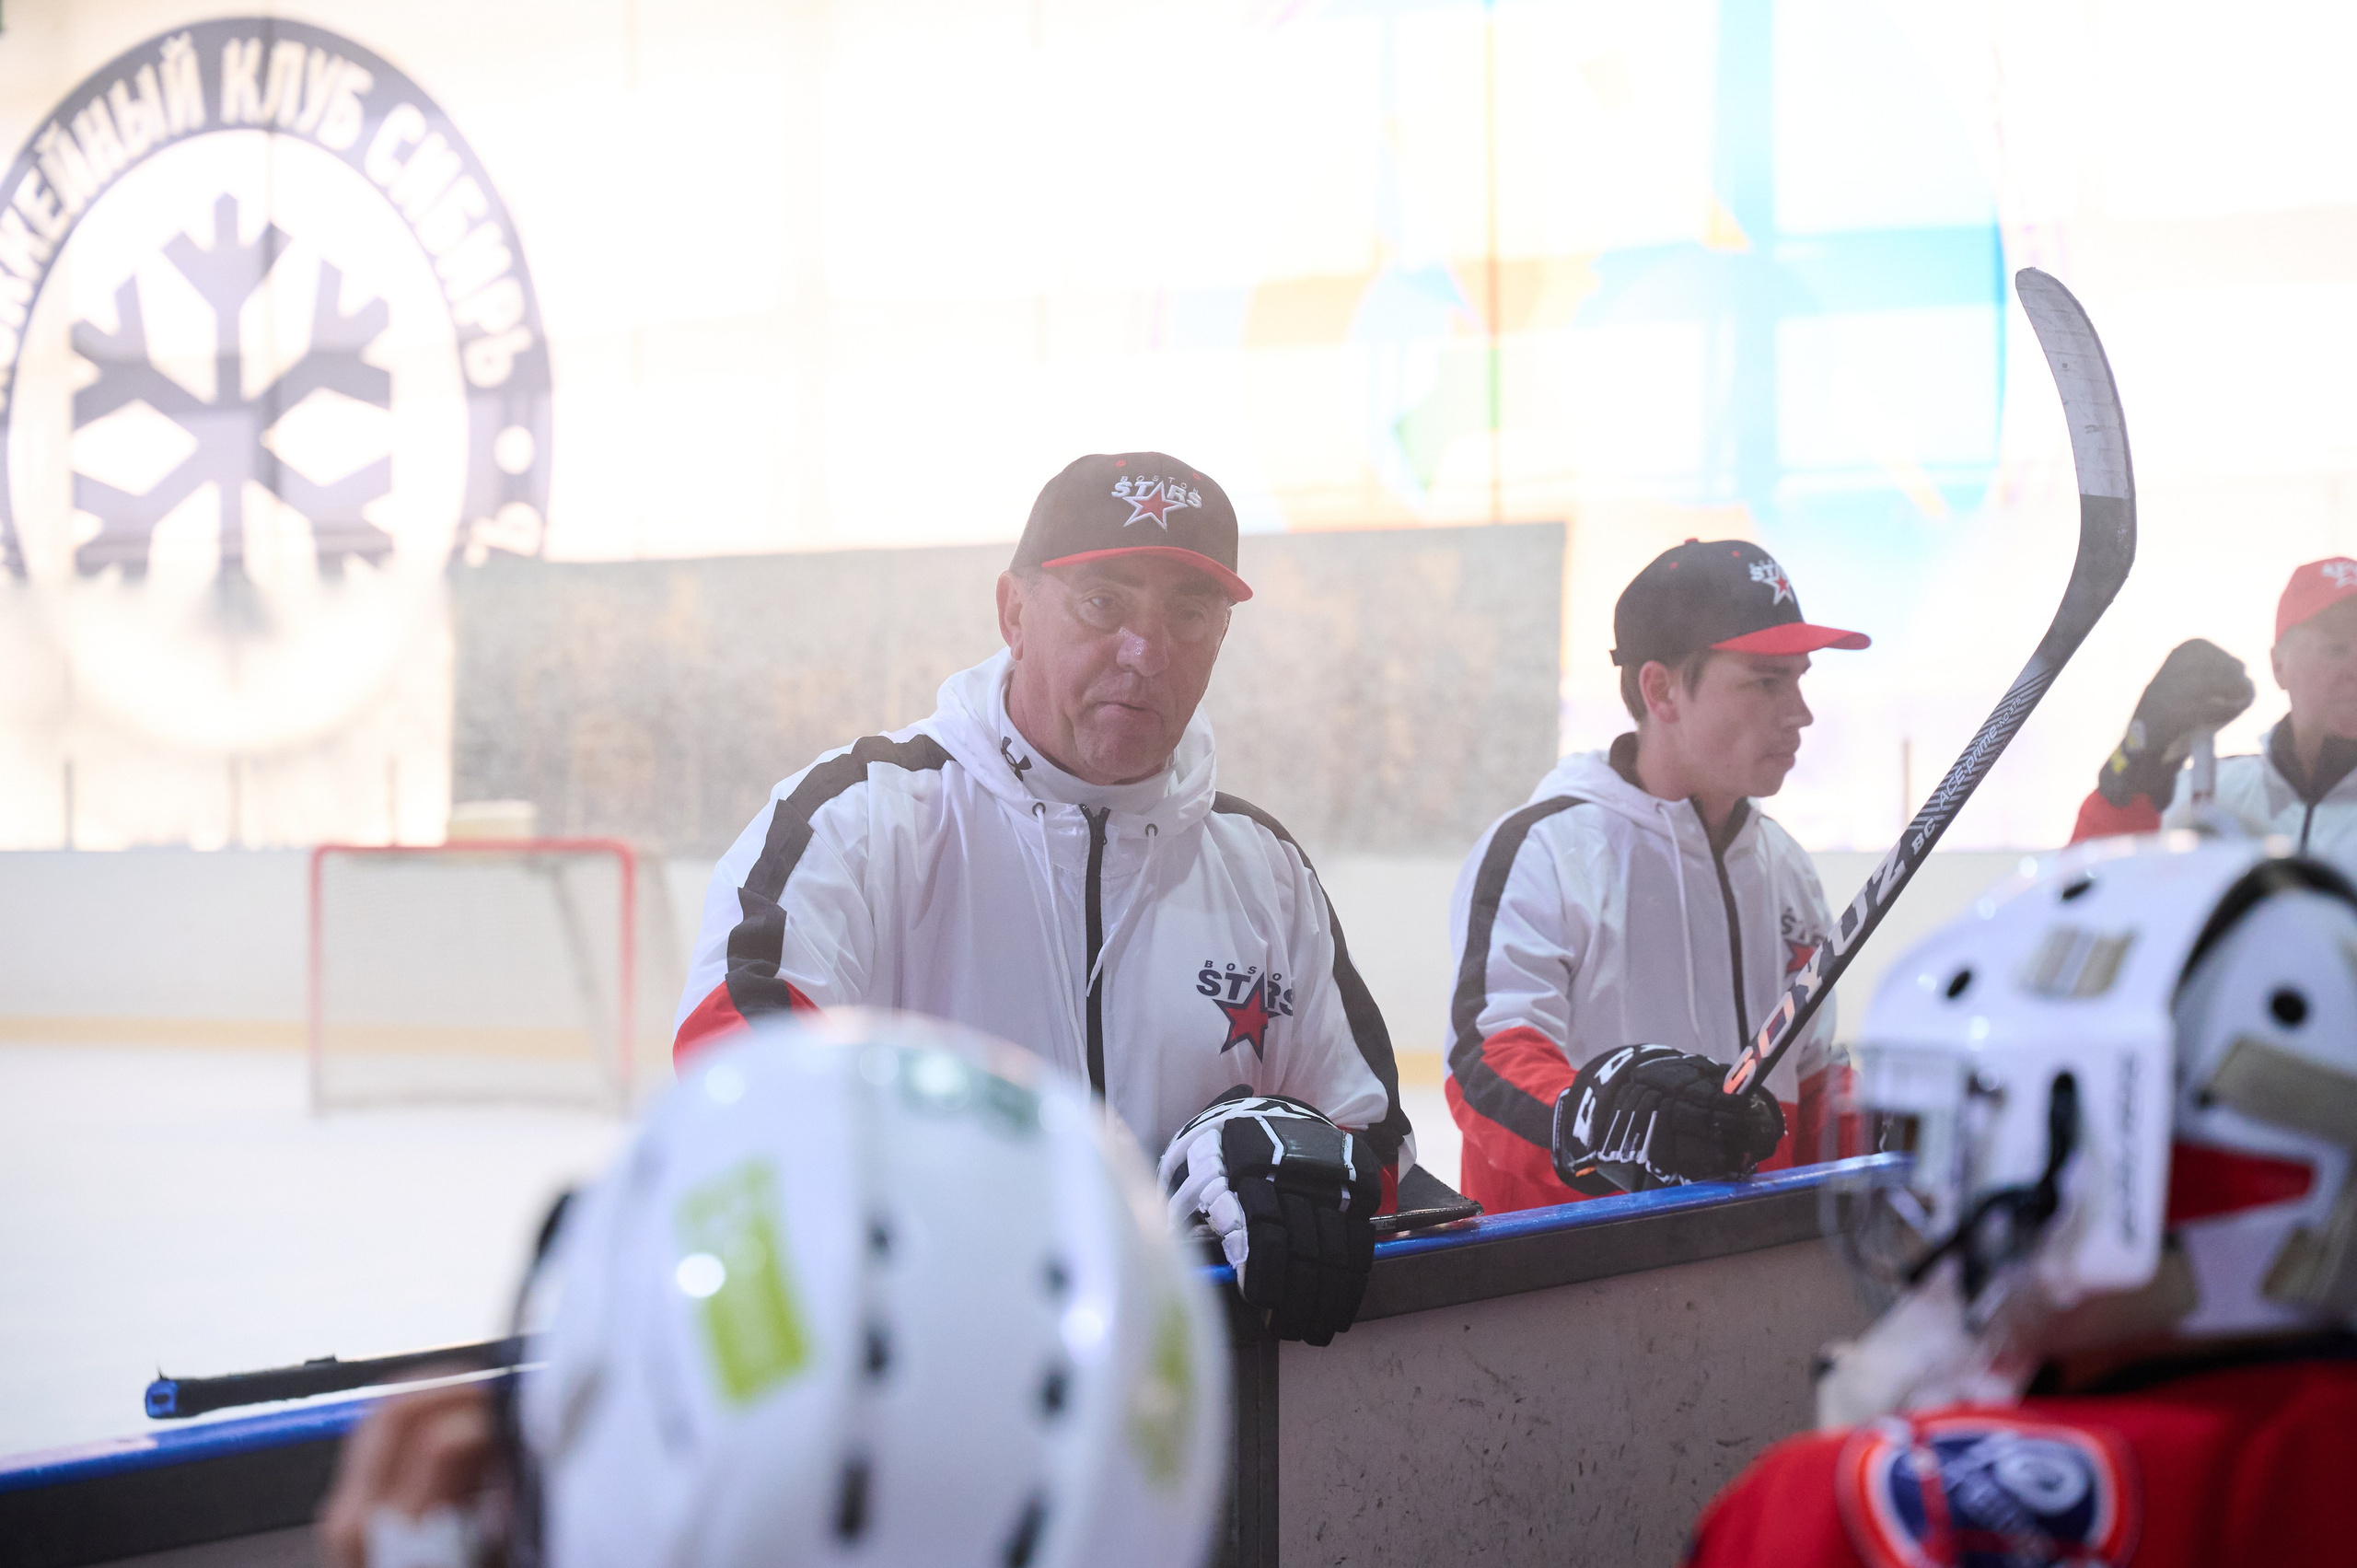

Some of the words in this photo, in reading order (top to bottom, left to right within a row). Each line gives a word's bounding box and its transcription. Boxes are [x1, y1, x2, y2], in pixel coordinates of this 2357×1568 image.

[219, 37, 375, 152] КЛУБ
[365, 101, 534, 389] СИБИРЬ
[1110, 480, 1202, 514] STARS
[1120, 475, 1199, 494] BOSTON
[1722, 839, 1907, 1096] SOYUZ
[1911, 817, 1937, 855] BC
[1938, 765, 1967, 810] ACE
[1966, 724, 1999, 774] prime
[1203, 959, 1283, 981] BOSO
